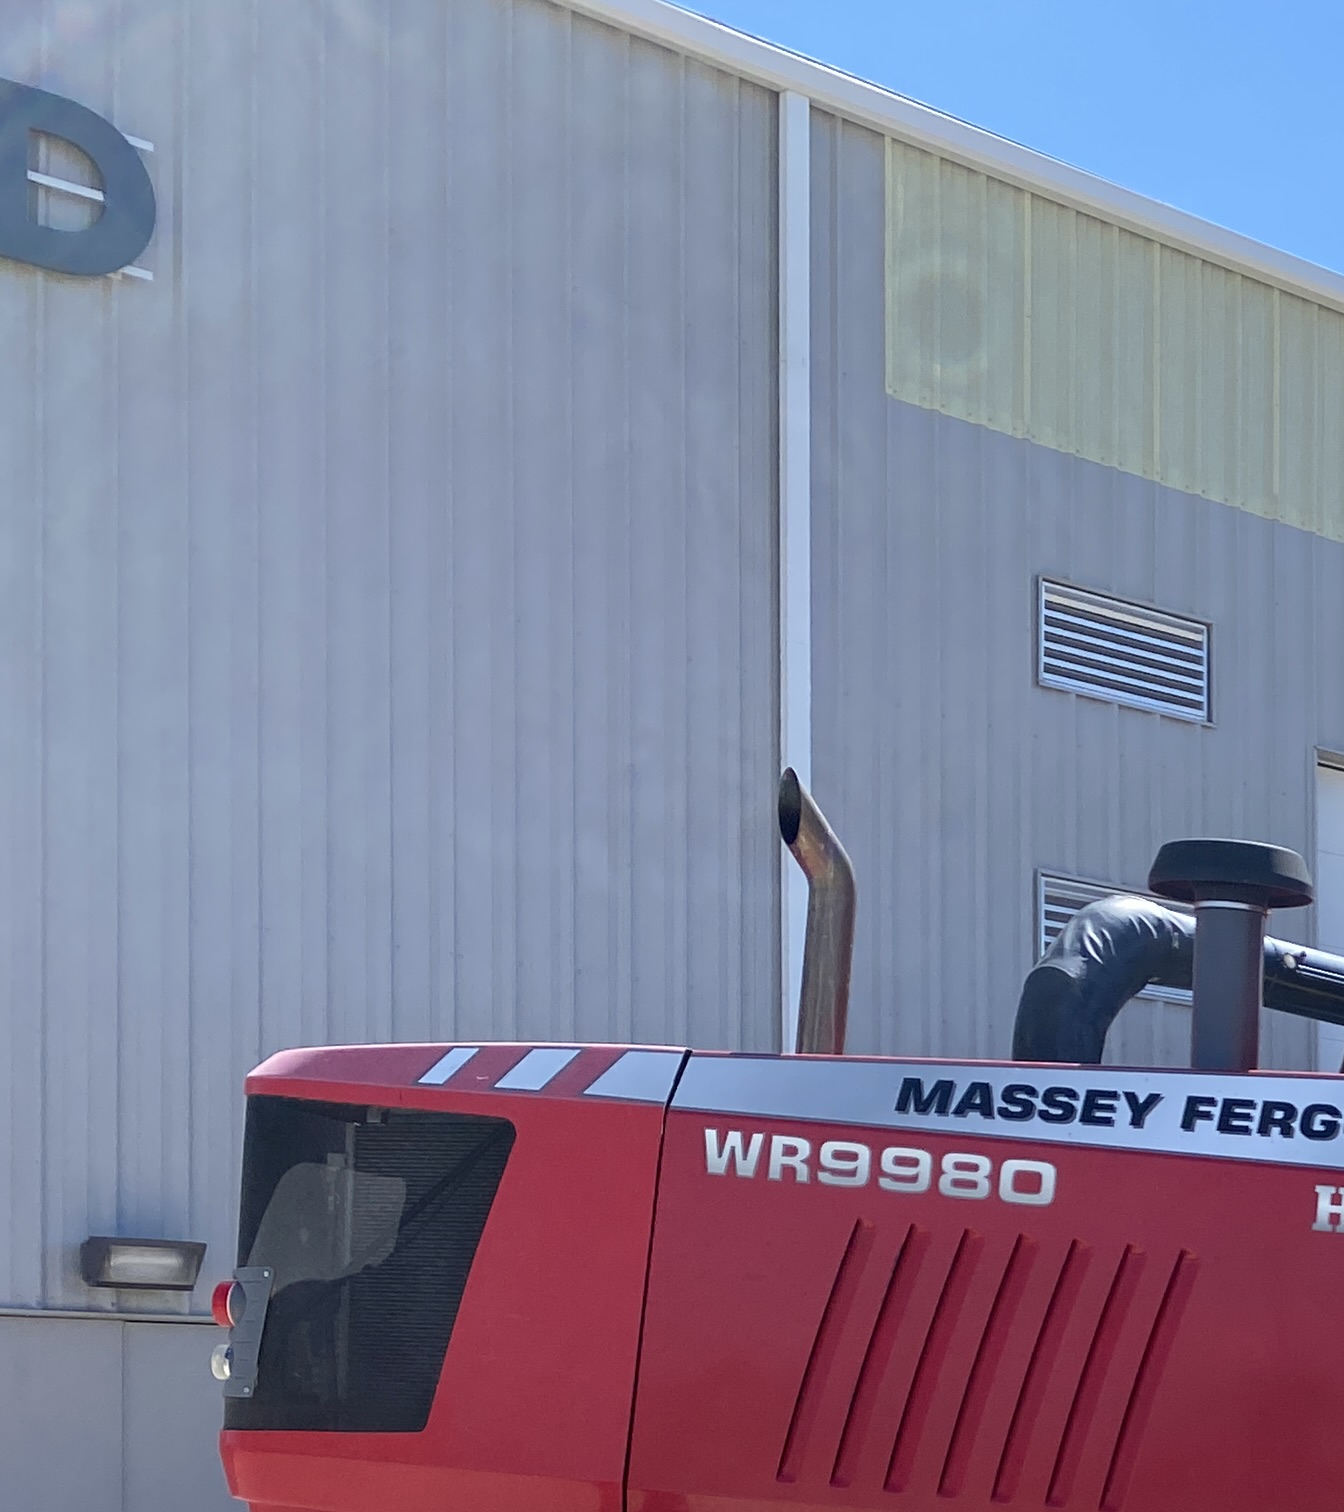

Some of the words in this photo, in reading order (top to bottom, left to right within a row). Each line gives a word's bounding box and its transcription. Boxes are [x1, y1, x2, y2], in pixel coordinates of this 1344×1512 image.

[0, 76, 156, 276] D
[894, 1076, 1165, 1130] MASSEY
[703, 1127, 1057, 1206] WR9980
